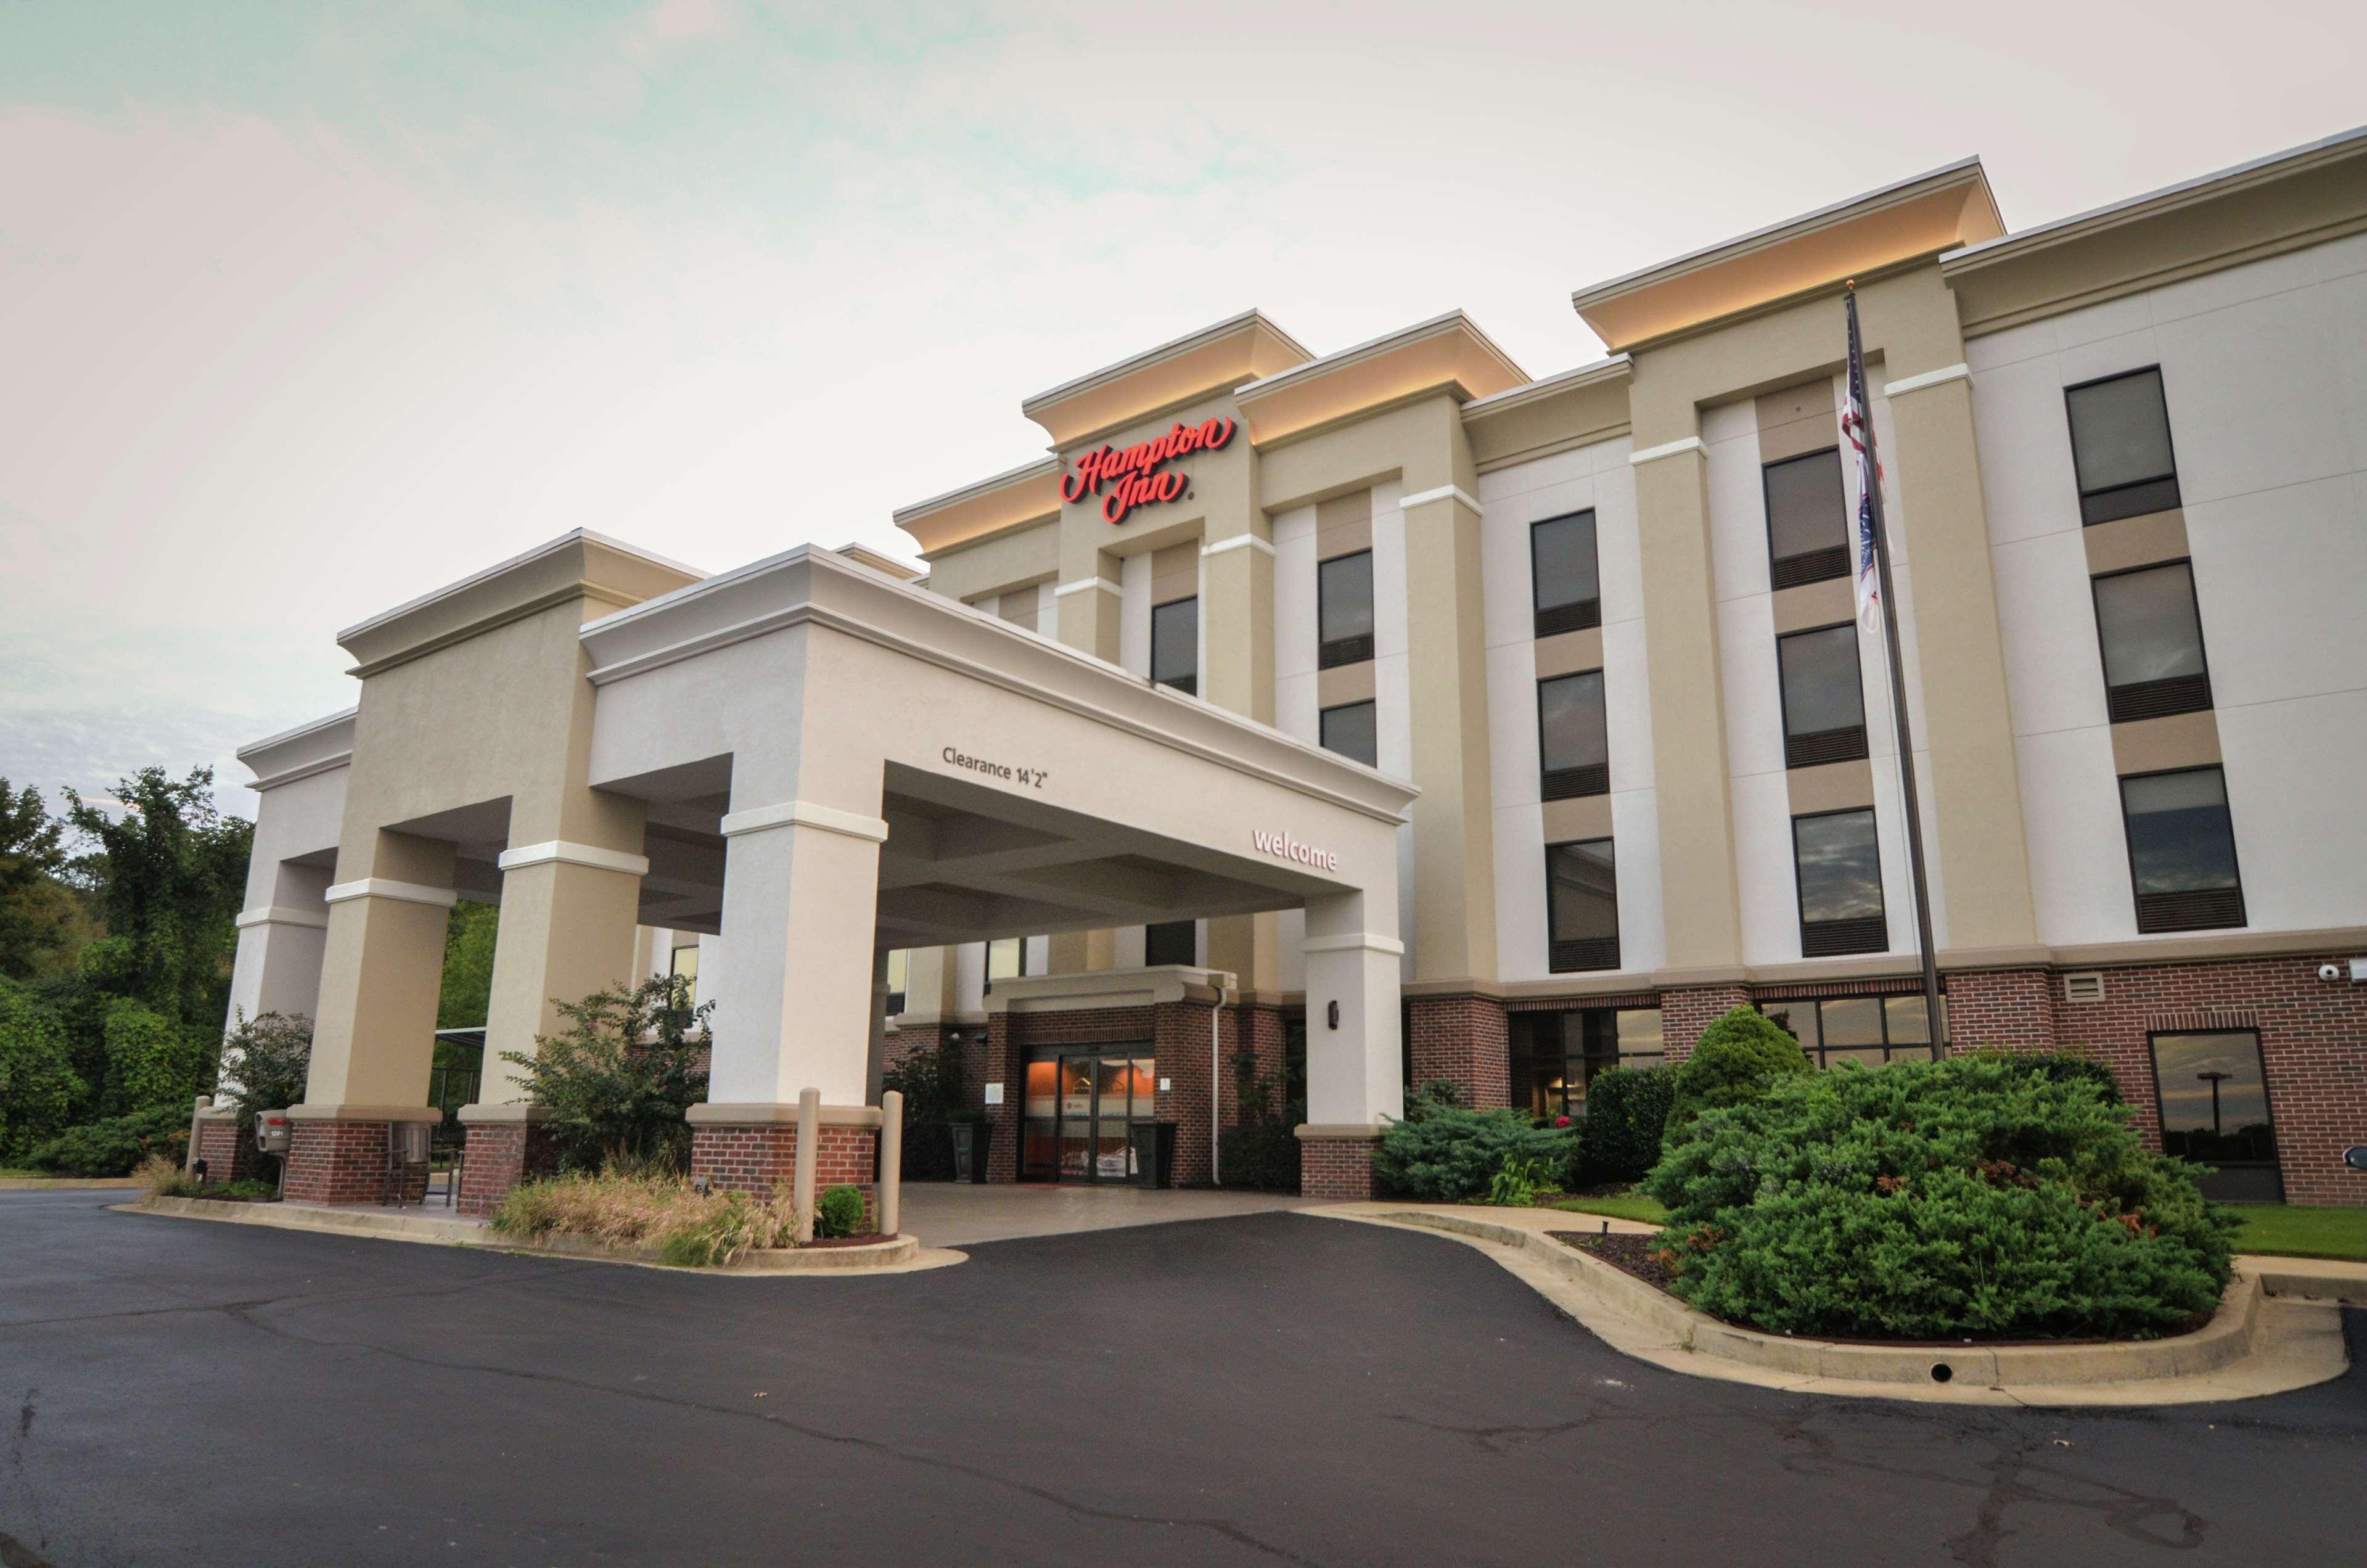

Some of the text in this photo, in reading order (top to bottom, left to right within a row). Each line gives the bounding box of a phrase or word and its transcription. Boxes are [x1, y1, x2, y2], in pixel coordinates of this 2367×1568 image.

[1060, 417, 1237, 504] Hampton
[1102, 470, 1189, 525] Inn
[943, 747, 1011, 779] Clearance
[1252, 830, 1338, 872] welcome
